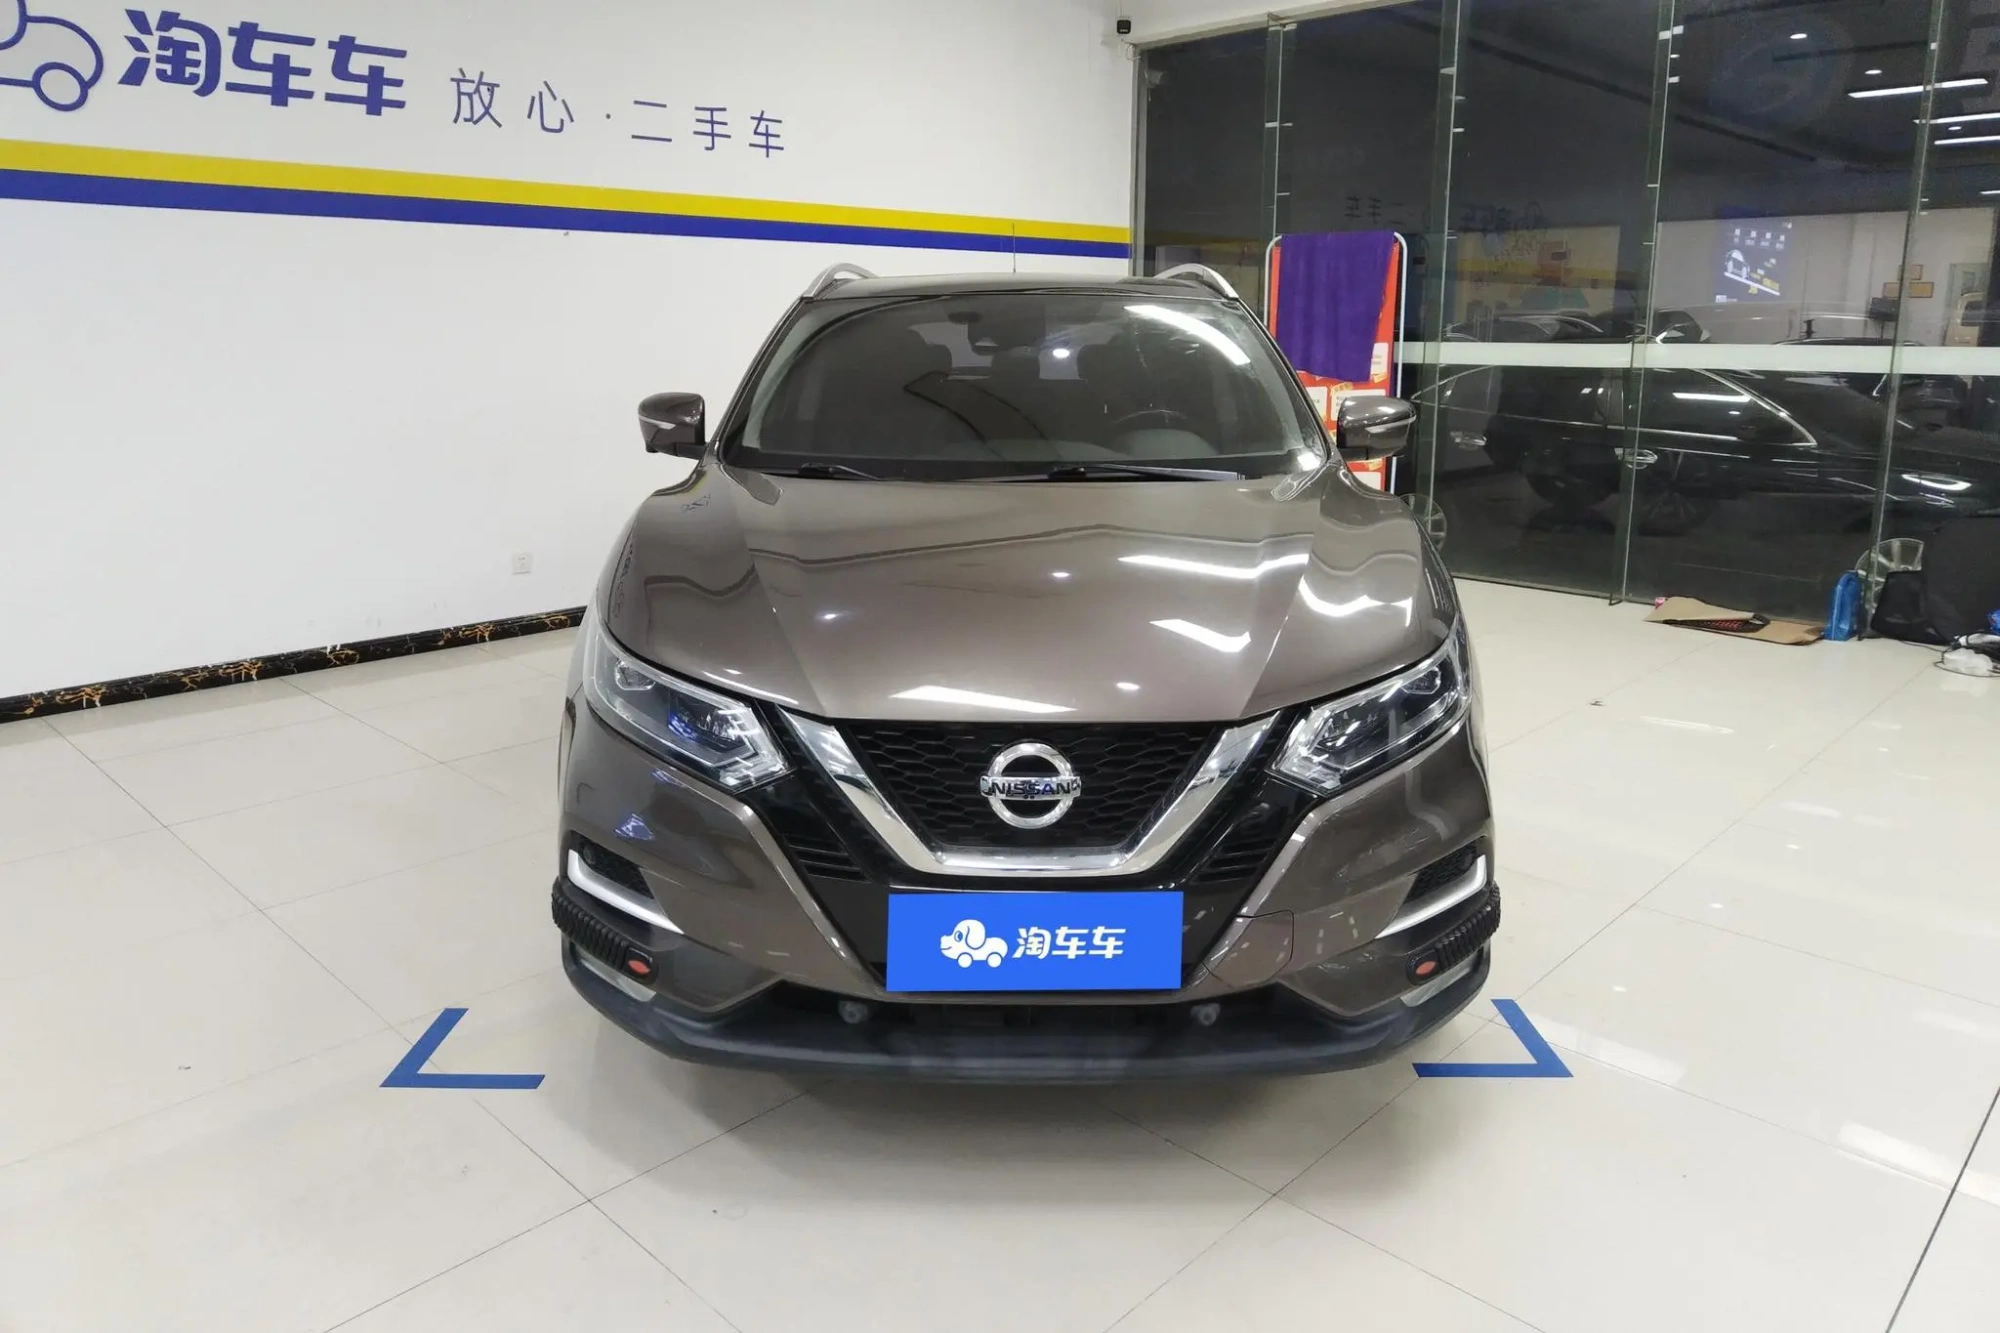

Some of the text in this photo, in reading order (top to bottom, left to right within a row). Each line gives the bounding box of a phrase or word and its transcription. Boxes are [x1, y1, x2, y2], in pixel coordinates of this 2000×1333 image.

[117, 8, 408, 116] 淘车车
[990, 781, 1071, 796] NISSAN
